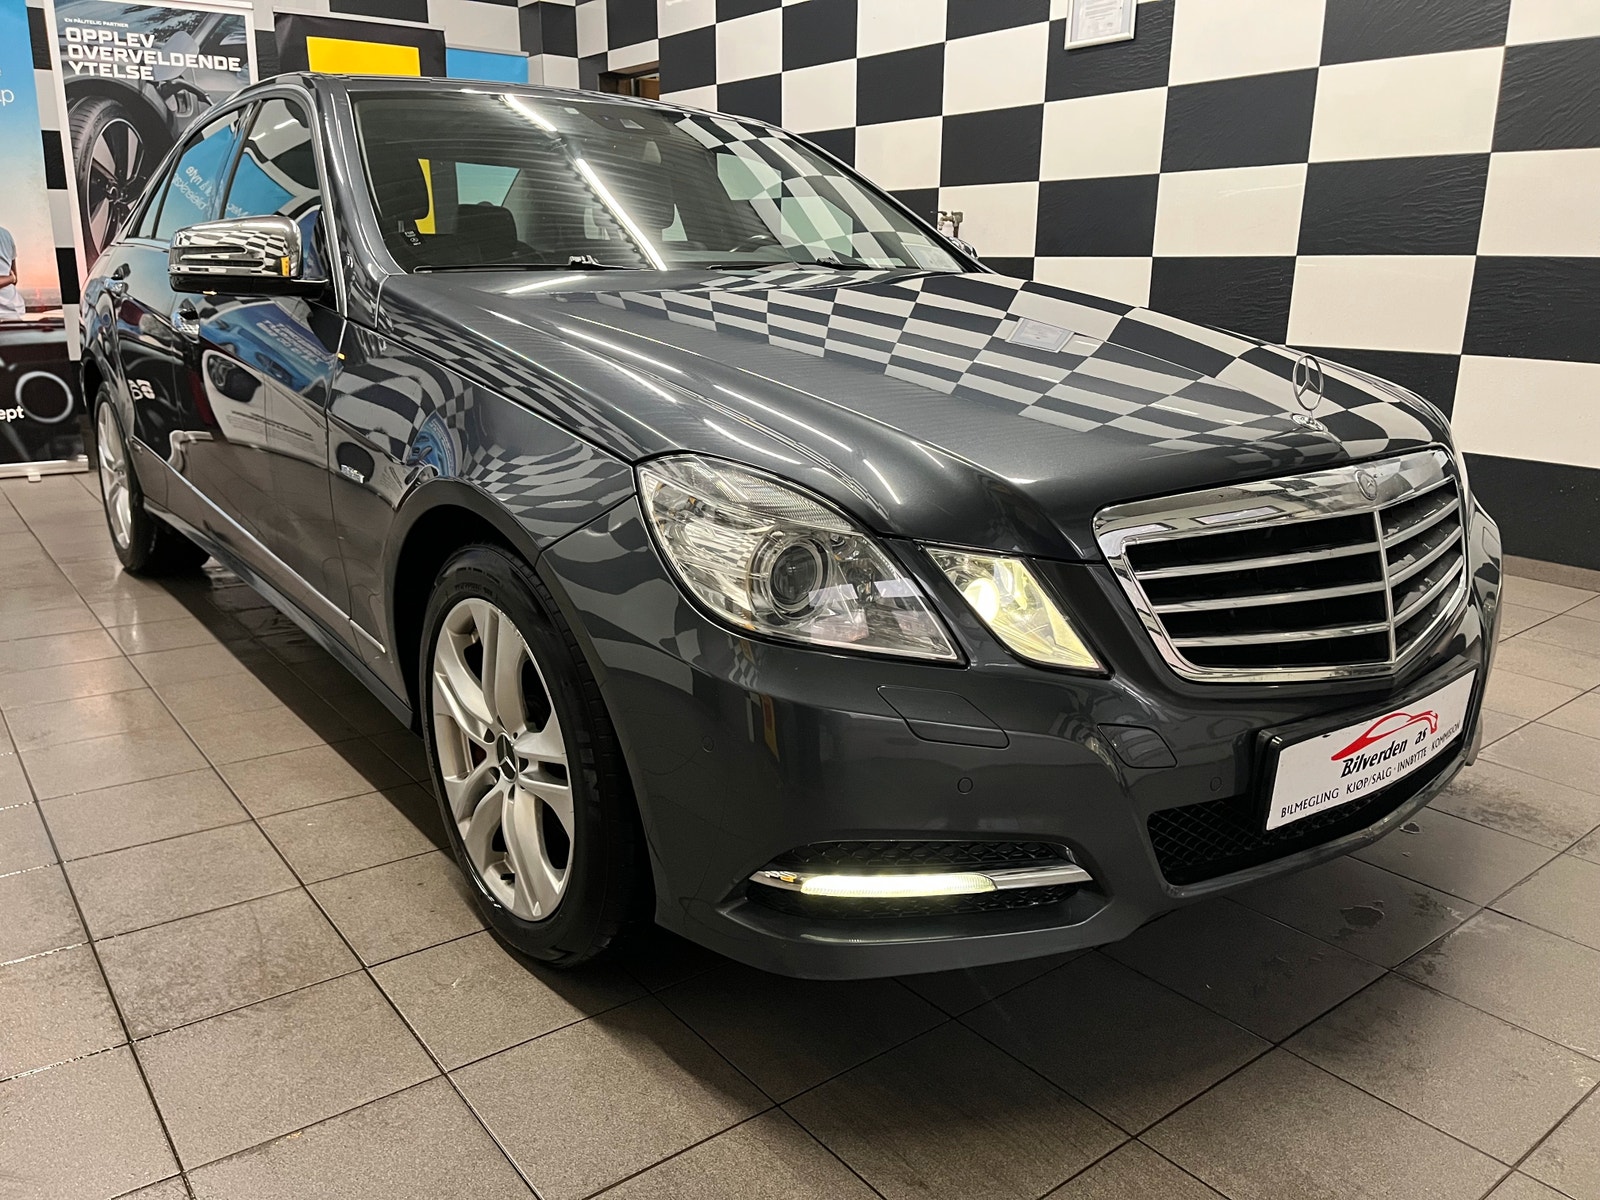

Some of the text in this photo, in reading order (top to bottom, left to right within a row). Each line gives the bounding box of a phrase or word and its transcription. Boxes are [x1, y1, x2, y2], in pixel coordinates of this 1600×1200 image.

[103, 20, 129, 28] PARTNER
[65, 26, 155, 48] OPPLEV
[67, 43, 242, 72] OVERVELDENDE
[68, 60, 154, 81] YTELSE
[0, 89, 15, 107] p
[1340, 727, 1428, 778] Bilverden as
[1281, 788, 1339, 818] BILMEGLING
[1346, 766, 1392, 795] KJØP/SALG
[1397, 746, 1427, 772] INNBYTTE
